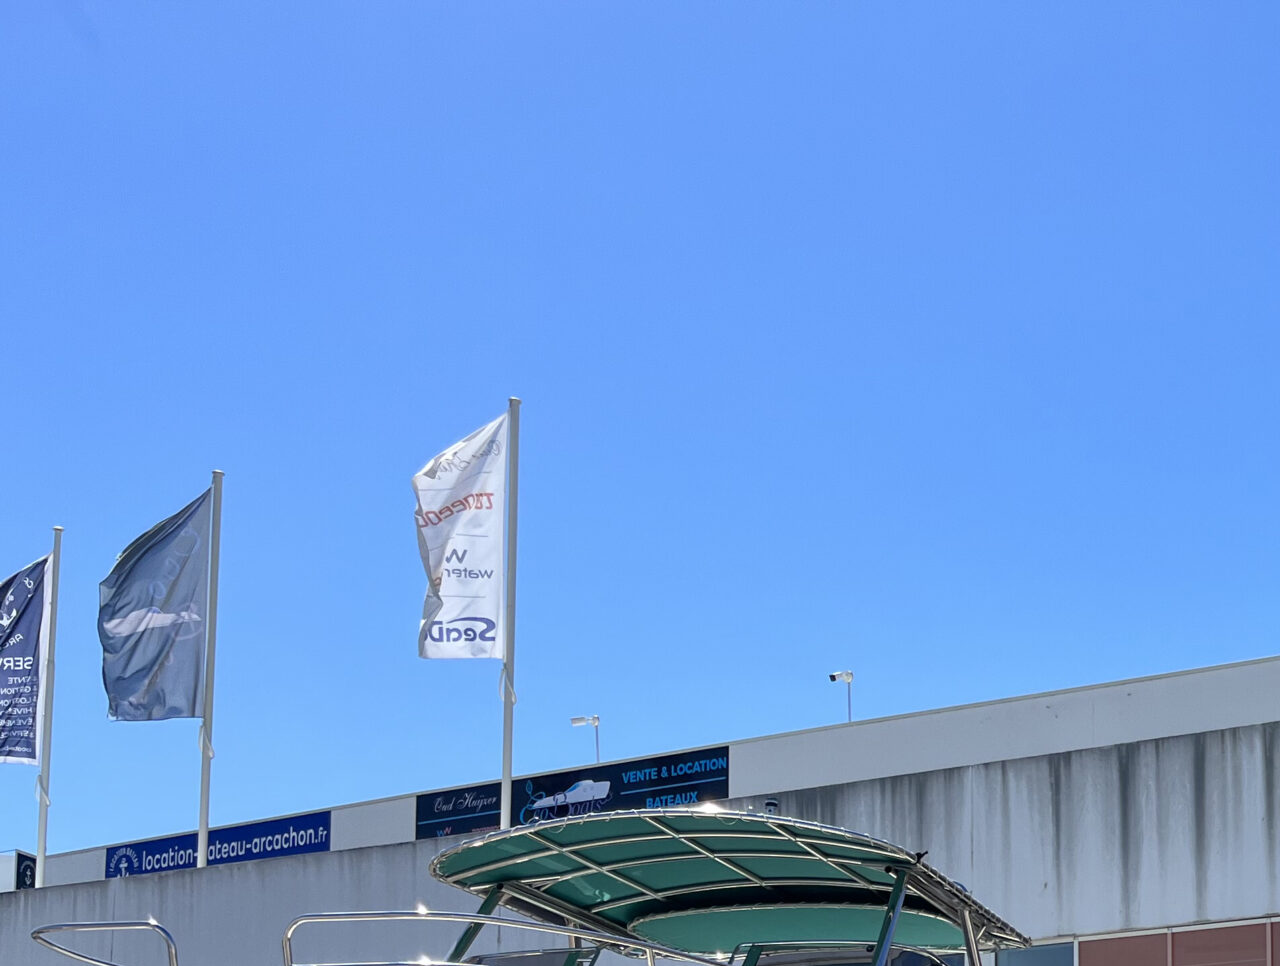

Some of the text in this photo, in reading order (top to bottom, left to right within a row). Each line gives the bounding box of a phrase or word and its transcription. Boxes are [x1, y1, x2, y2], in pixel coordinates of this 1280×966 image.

[622, 757, 727, 784] VENTE & LOCATION
[646, 792, 698, 809] BATEAUX
[142, 826, 327, 872] location-ateau-arcachon.fr
